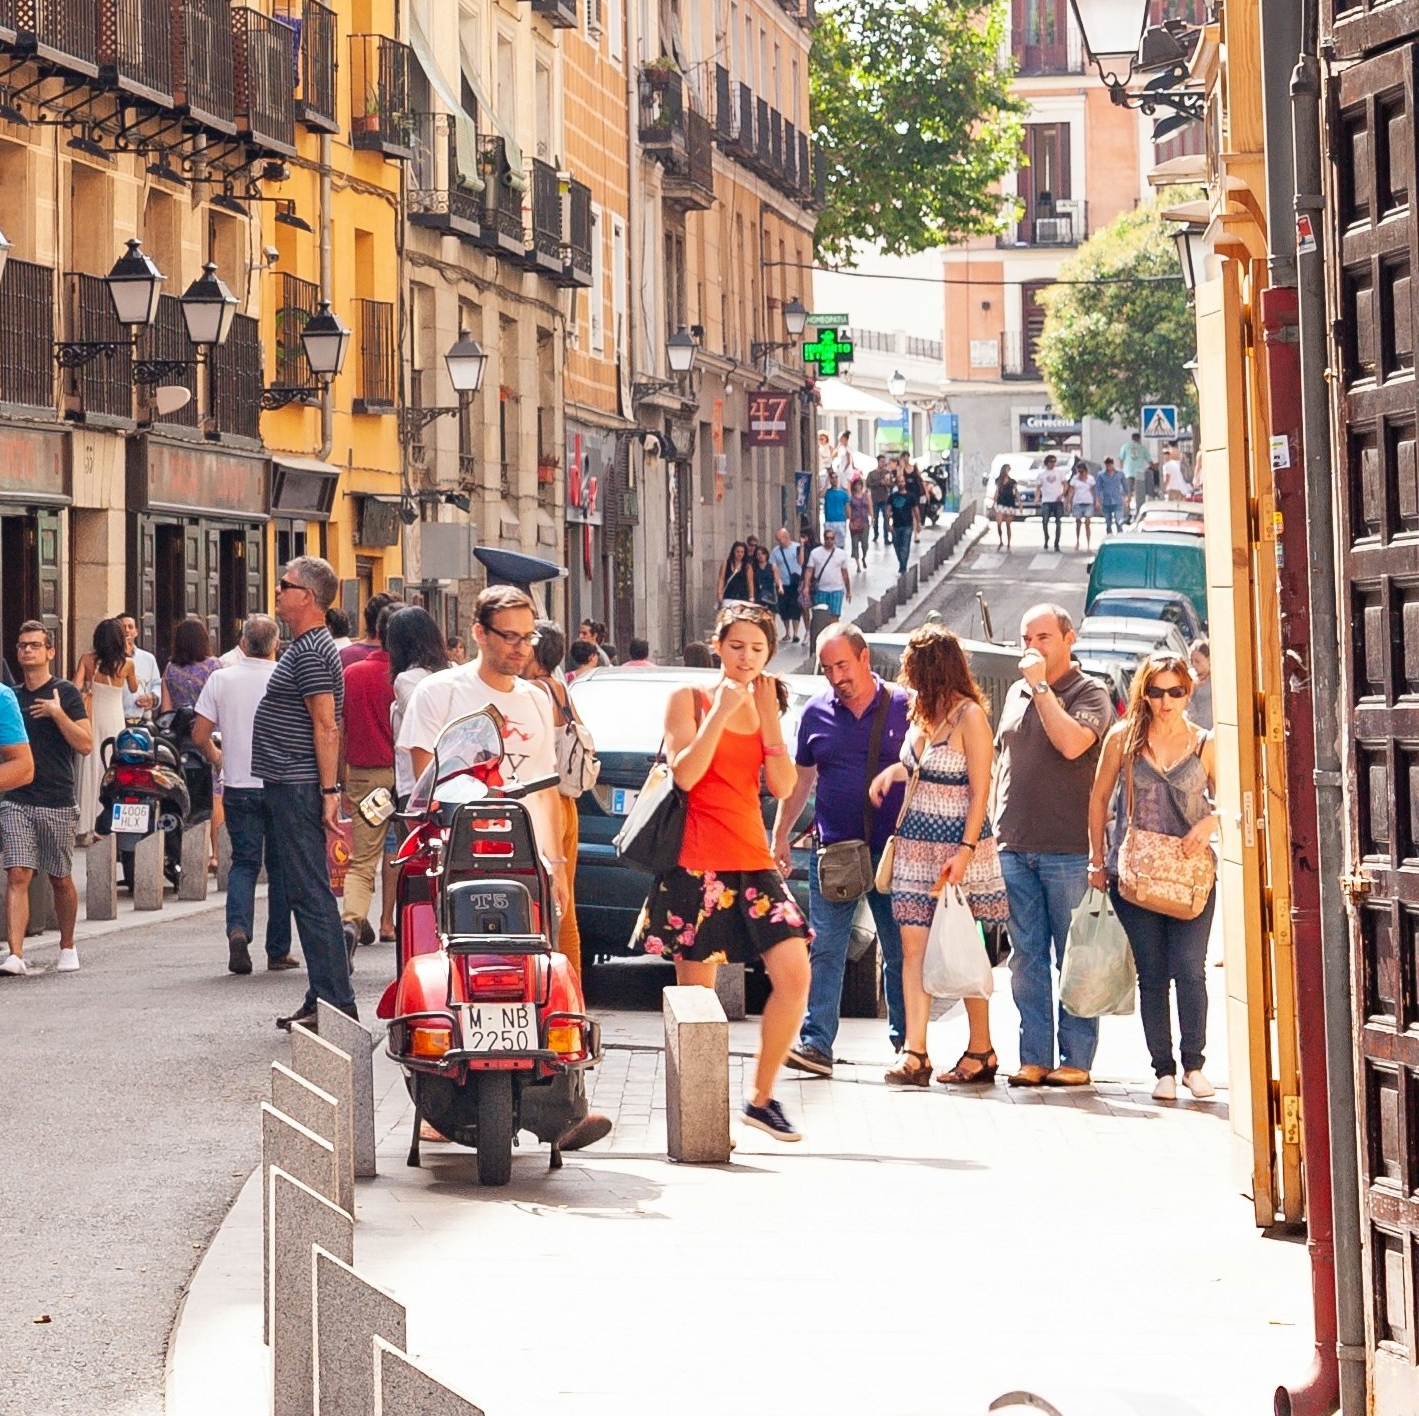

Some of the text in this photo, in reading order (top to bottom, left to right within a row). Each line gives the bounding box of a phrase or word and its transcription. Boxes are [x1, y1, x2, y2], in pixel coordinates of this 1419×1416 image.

[750, 398, 788, 440] 47
[122, 806, 147, 817] 4006
[470, 893, 509, 910] T5
[472, 1030, 529, 1053] 2250
